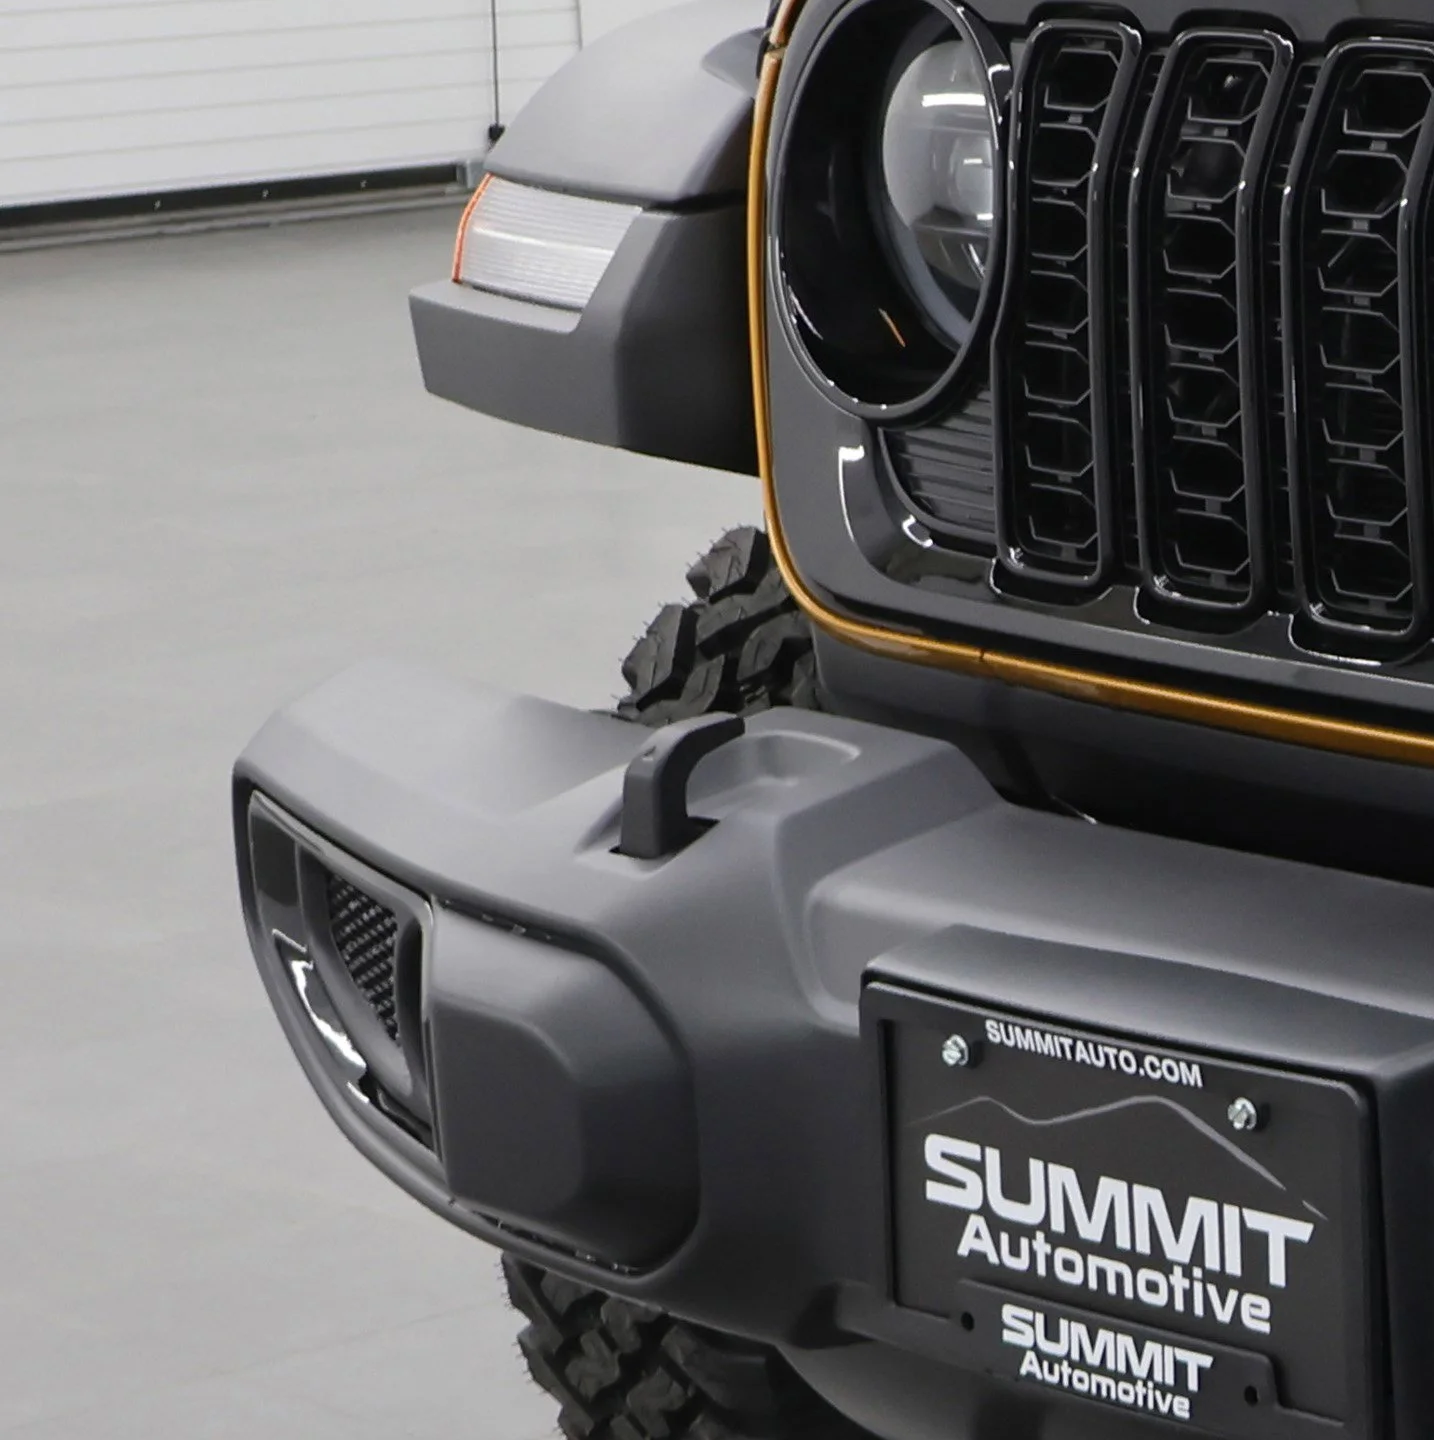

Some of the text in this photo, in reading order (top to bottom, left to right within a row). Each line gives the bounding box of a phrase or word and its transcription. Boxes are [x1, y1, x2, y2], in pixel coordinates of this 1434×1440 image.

[985, 1018, 1204, 1088] SUMMITAUTO.COM
[924, 1132, 1314, 1289] SUMMIT
[957, 1215, 1271, 1334] Automotive
[1001, 1303, 1213, 1392] SUMMIT
[1019, 1349, 1191, 1420] Automotive
